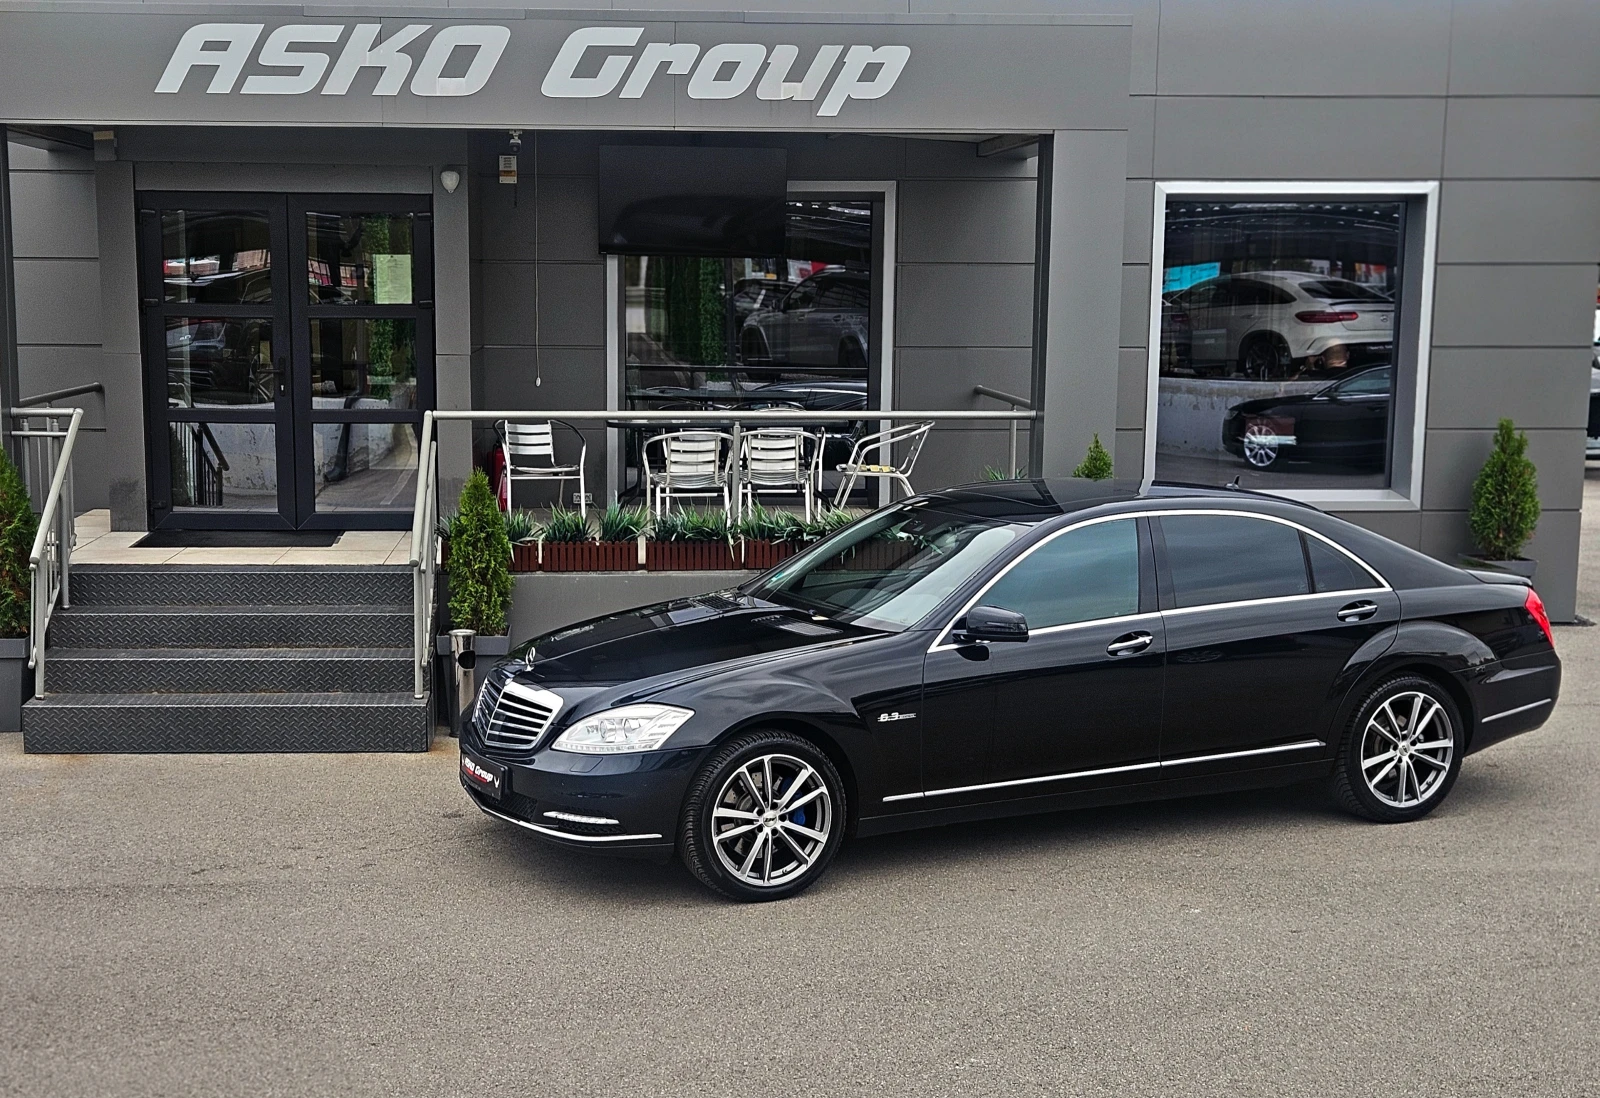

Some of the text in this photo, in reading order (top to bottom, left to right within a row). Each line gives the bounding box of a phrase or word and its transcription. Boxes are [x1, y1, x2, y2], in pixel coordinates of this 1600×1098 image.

[153, 23, 911, 117] ASKO Group
[475, 765, 494, 783] Group
